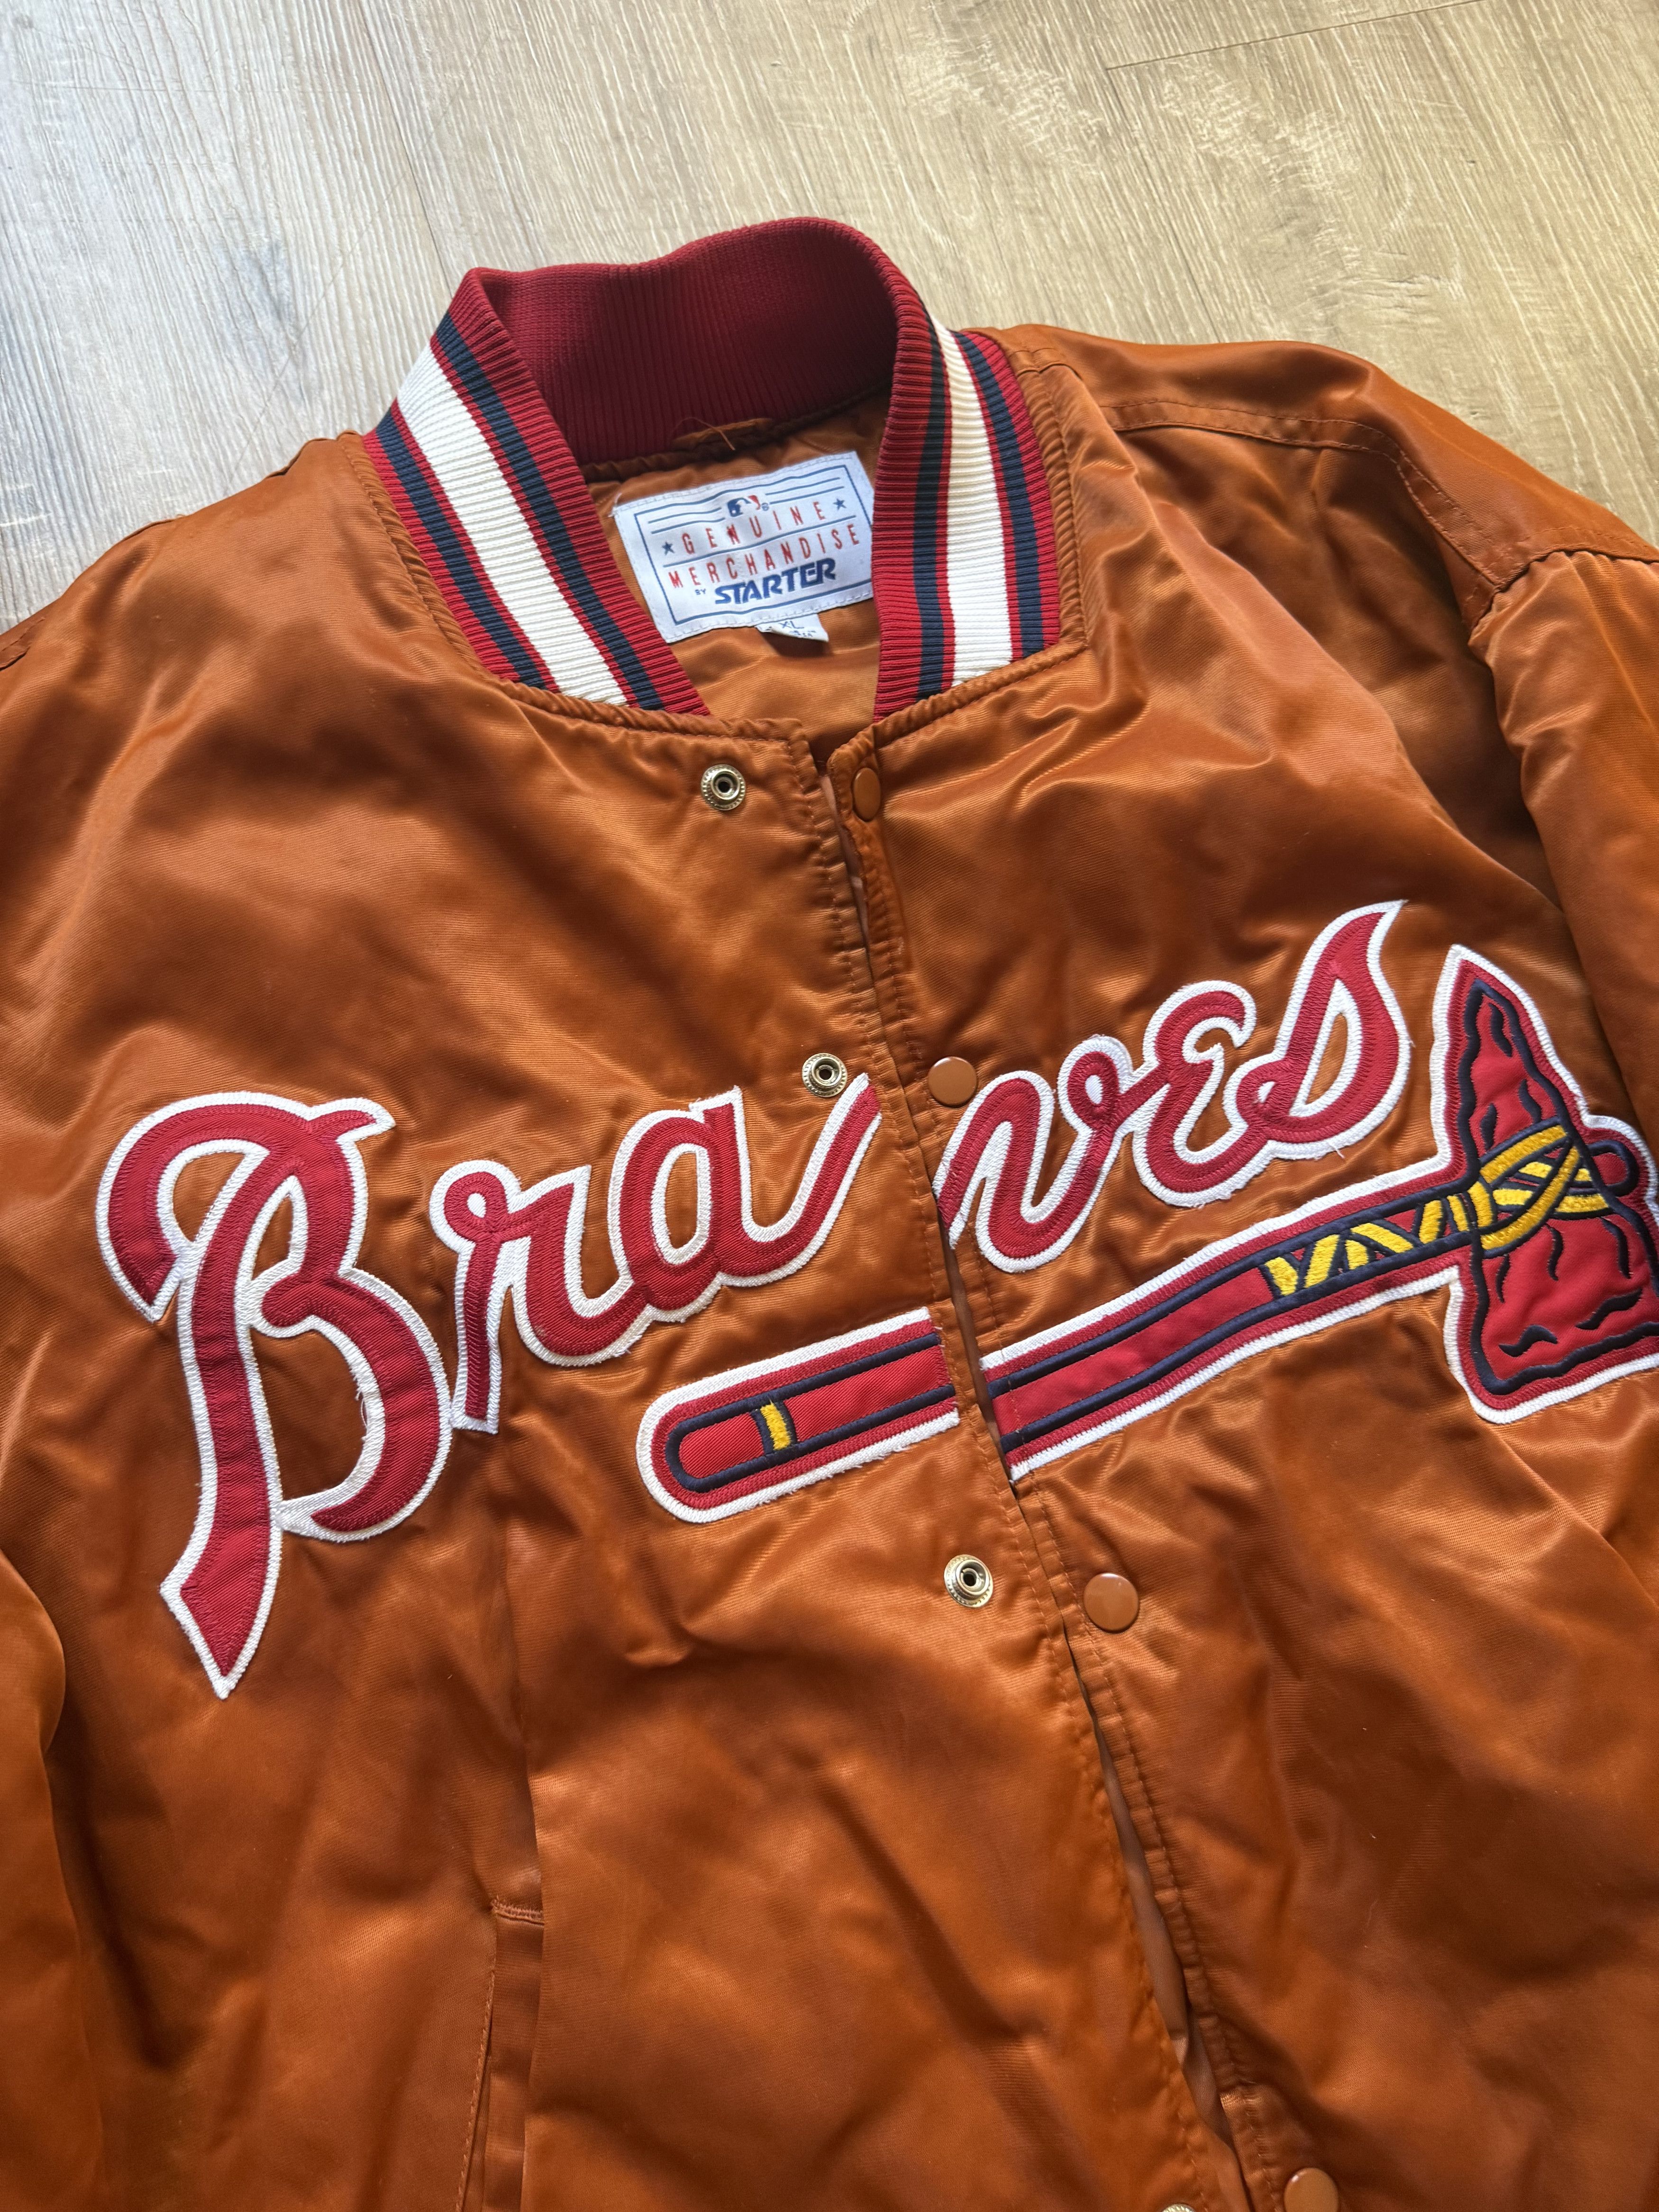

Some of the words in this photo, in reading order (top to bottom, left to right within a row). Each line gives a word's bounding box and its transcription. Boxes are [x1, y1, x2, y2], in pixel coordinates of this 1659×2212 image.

[668, 524, 859, 588] MERCHANDISE
[681, 501, 827, 555] GENUINE
[715, 557, 836, 604] STARTER
[96, 901, 1413, 1700] Braves
